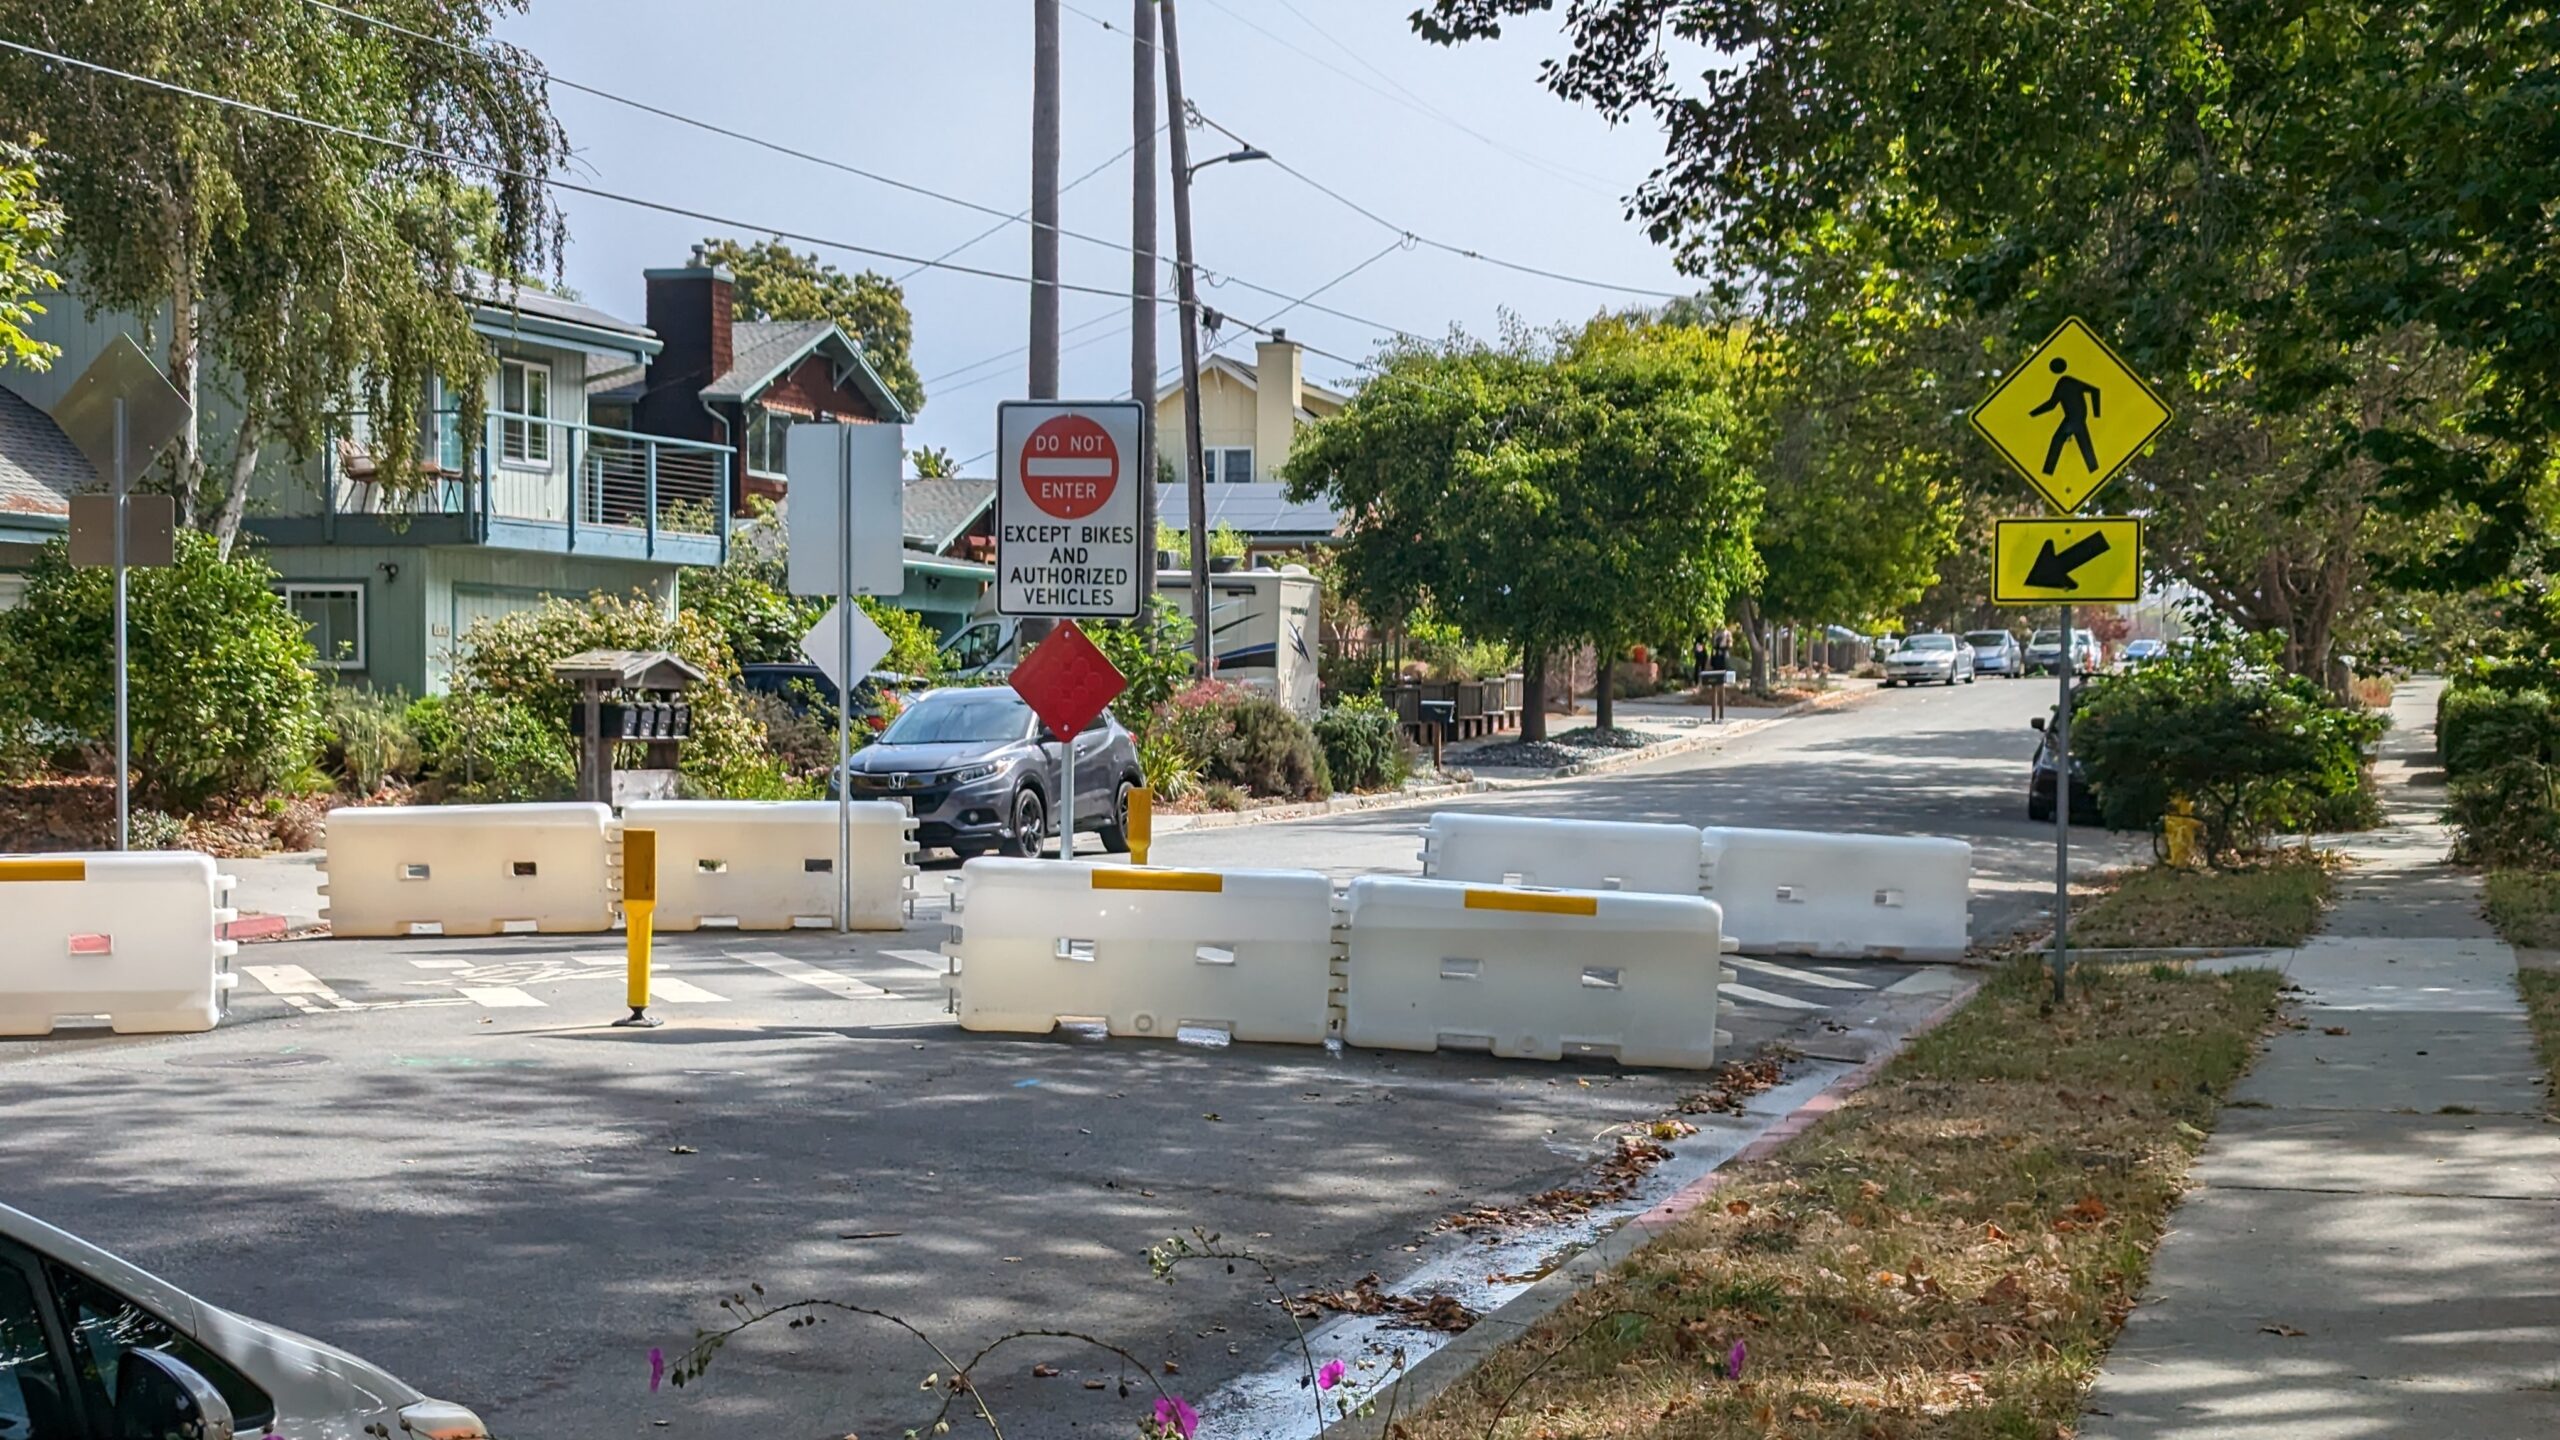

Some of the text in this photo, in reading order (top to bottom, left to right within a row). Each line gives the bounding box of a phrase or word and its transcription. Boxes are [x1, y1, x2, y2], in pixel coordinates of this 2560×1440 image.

[1036, 435, 1104, 452] DO NOT
[1041, 482, 1097, 499] ENTER
[1004, 525, 1134, 544] EXCEPT BIKES
[1049, 547, 1089, 564] AND
[1010, 567, 1128, 585] AUTHORIZED
[1023, 588, 1114, 606] VEHICLES
